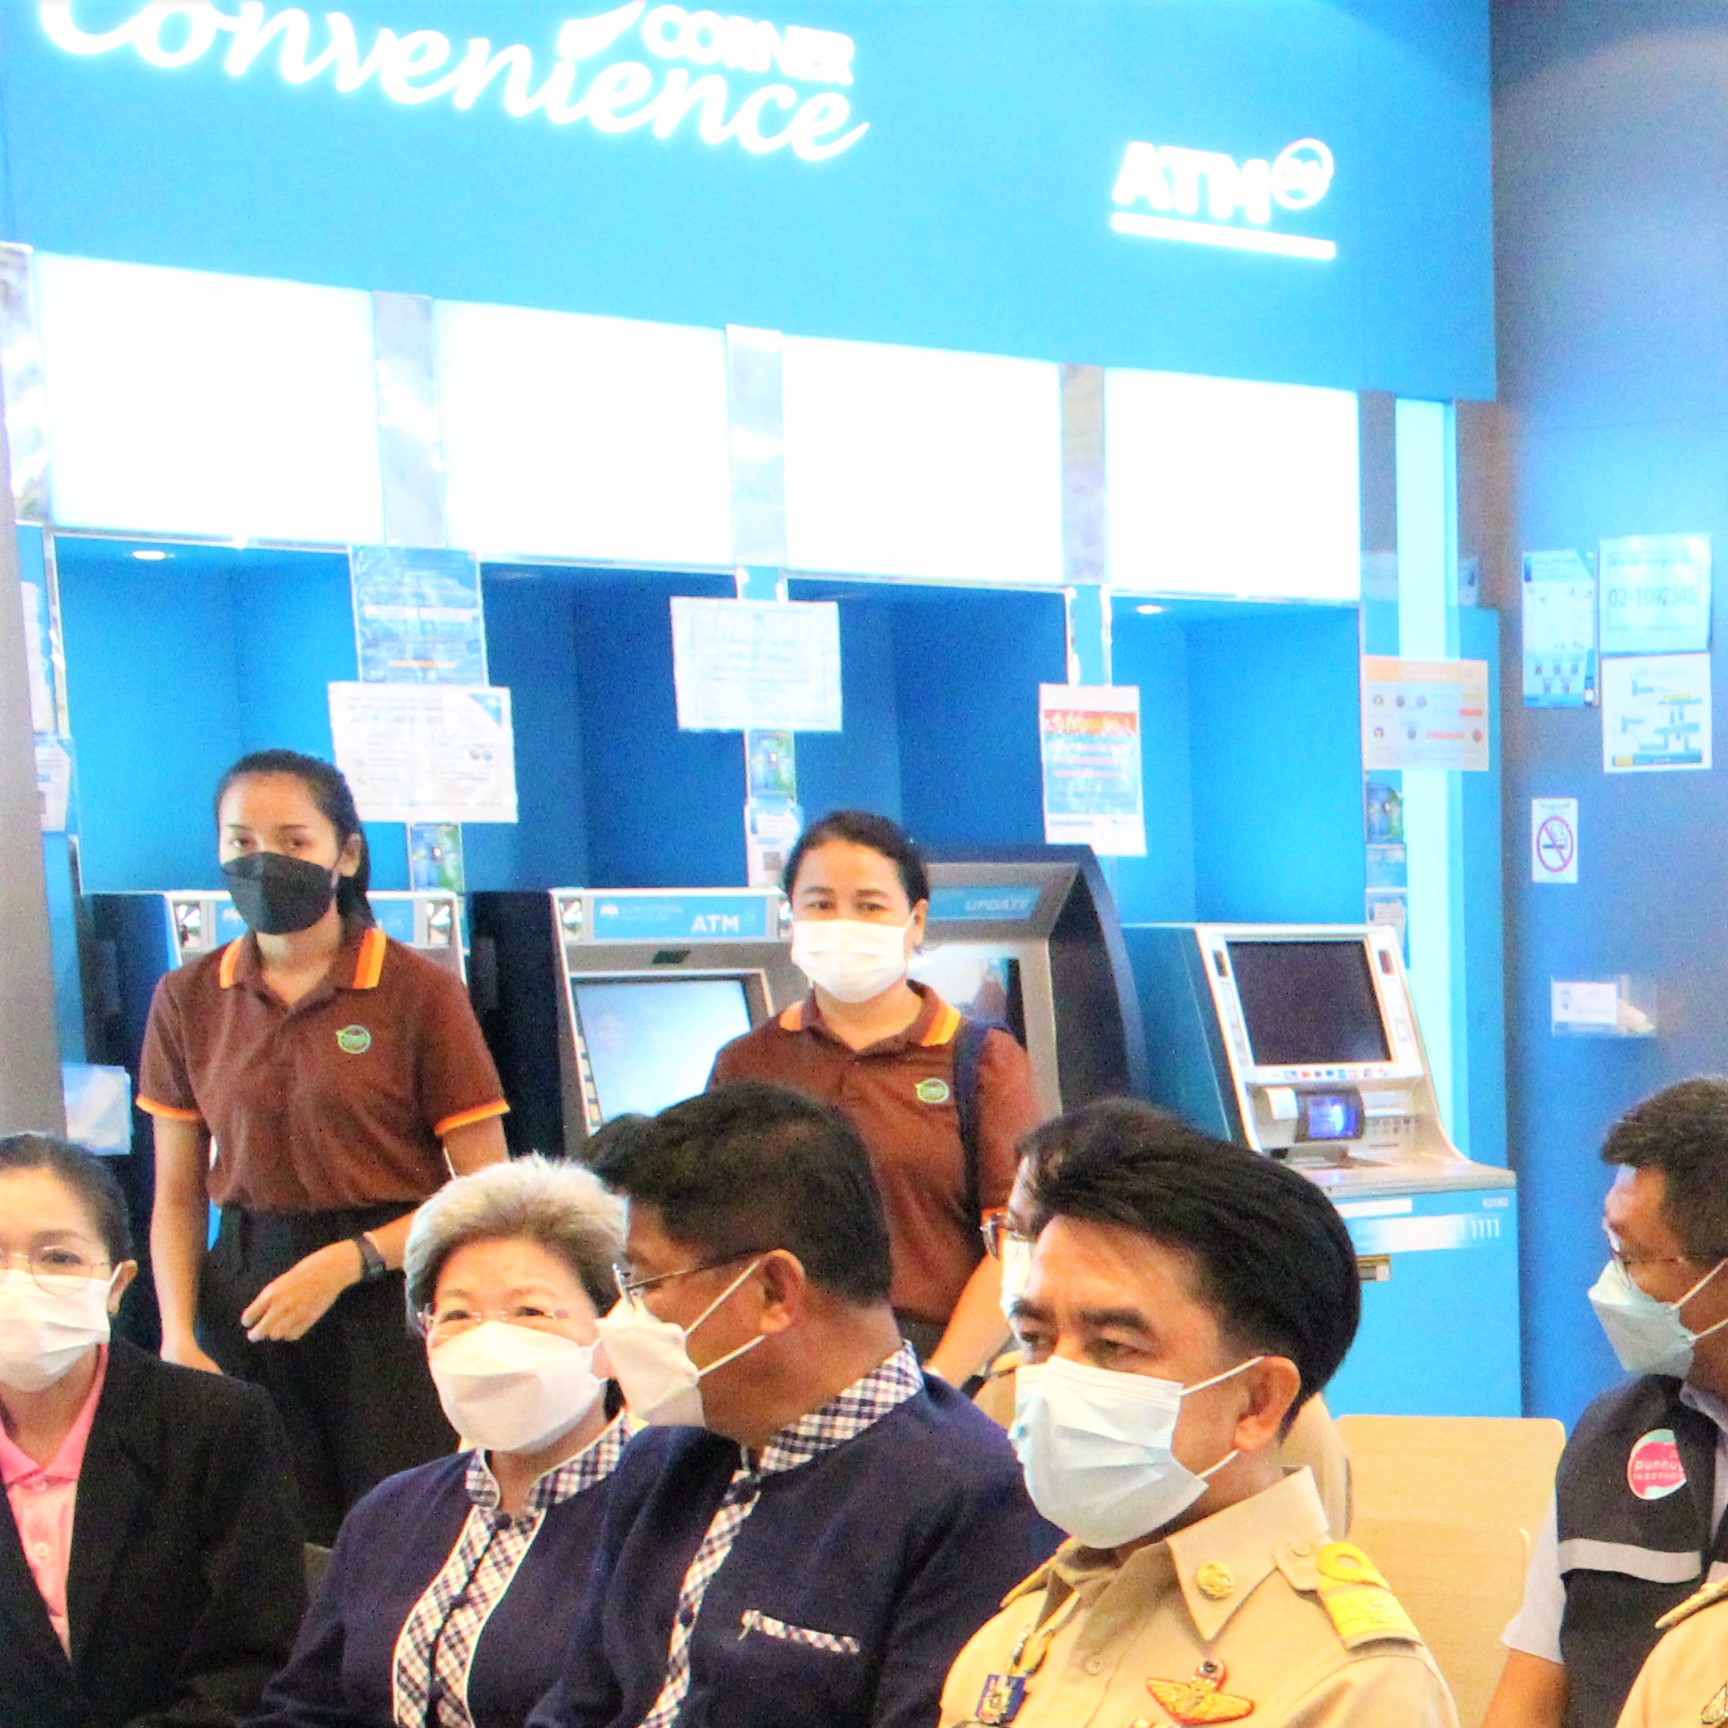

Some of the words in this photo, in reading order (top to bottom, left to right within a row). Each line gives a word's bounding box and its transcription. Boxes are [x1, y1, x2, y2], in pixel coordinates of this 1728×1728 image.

[641, 2, 856, 86] CORNER
[1111, 142, 1271, 224] ATM
[690, 915, 740, 933] ATM
